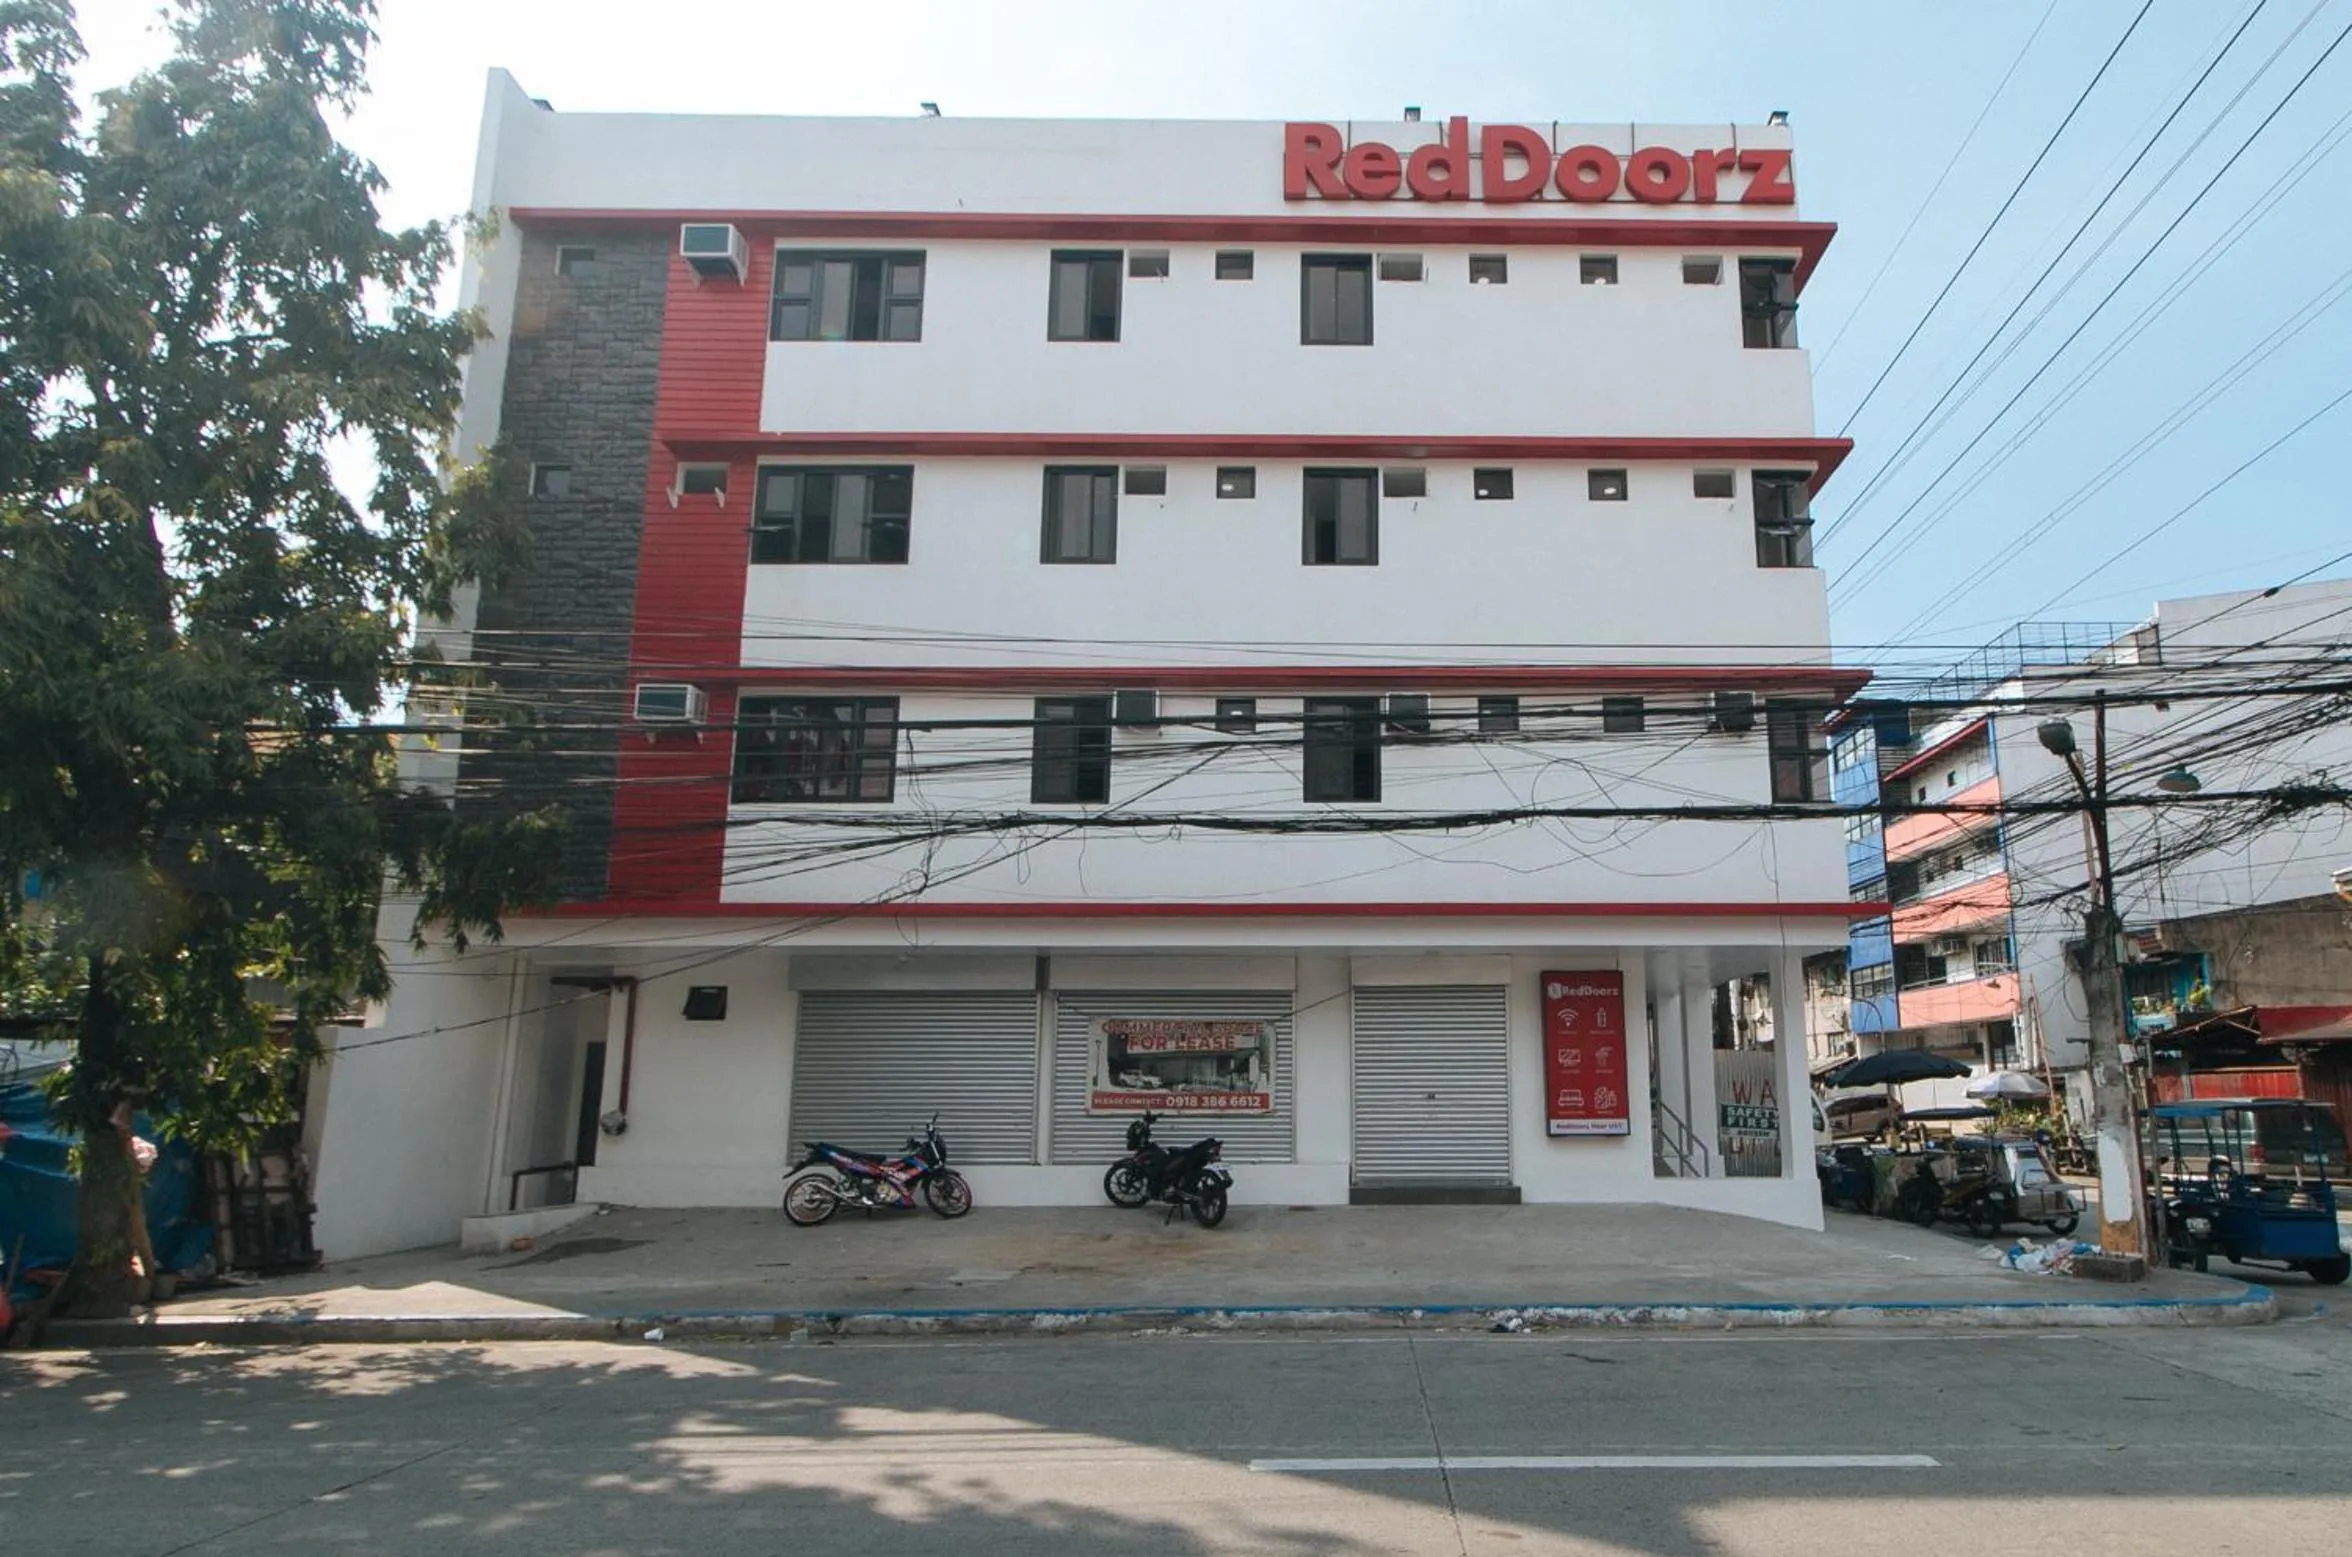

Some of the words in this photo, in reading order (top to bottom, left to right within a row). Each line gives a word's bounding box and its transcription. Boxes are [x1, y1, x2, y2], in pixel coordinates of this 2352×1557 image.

[1283, 116, 1795, 205] RedDoorz
[1129, 1035, 1168, 1050] FOR
[1176, 1035, 1235, 1050] LEASE
[1166, 1095, 1198, 1107] 0918
[1201, 1096, 1227, 1107] 386
[1230, 1096, 1261, 1107] 6612
